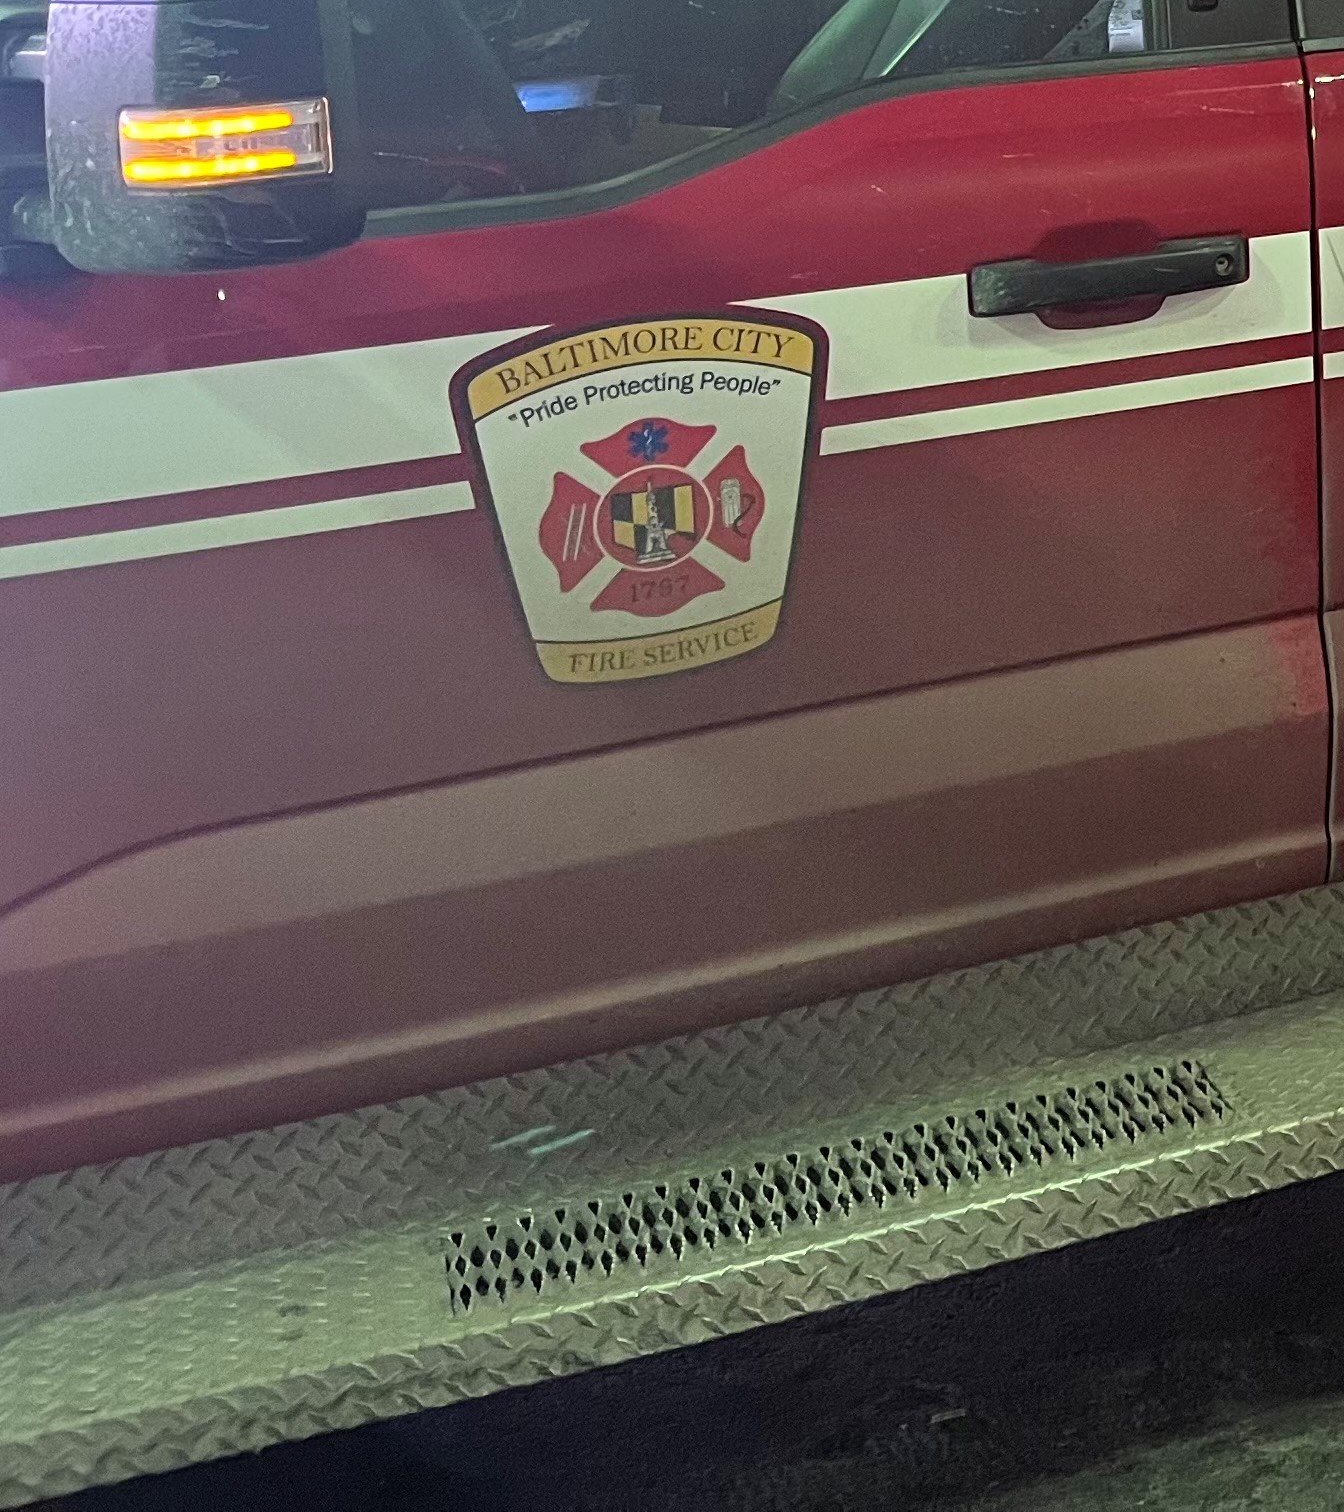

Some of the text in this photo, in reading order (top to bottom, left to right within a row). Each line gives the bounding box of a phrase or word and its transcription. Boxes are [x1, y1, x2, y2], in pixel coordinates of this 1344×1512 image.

[496, 326, 796, 394] BALTIMORE CITY
[583, 372, 695, 405] Protecting
[568, 621, 759, 673] FIRE SERVICE
